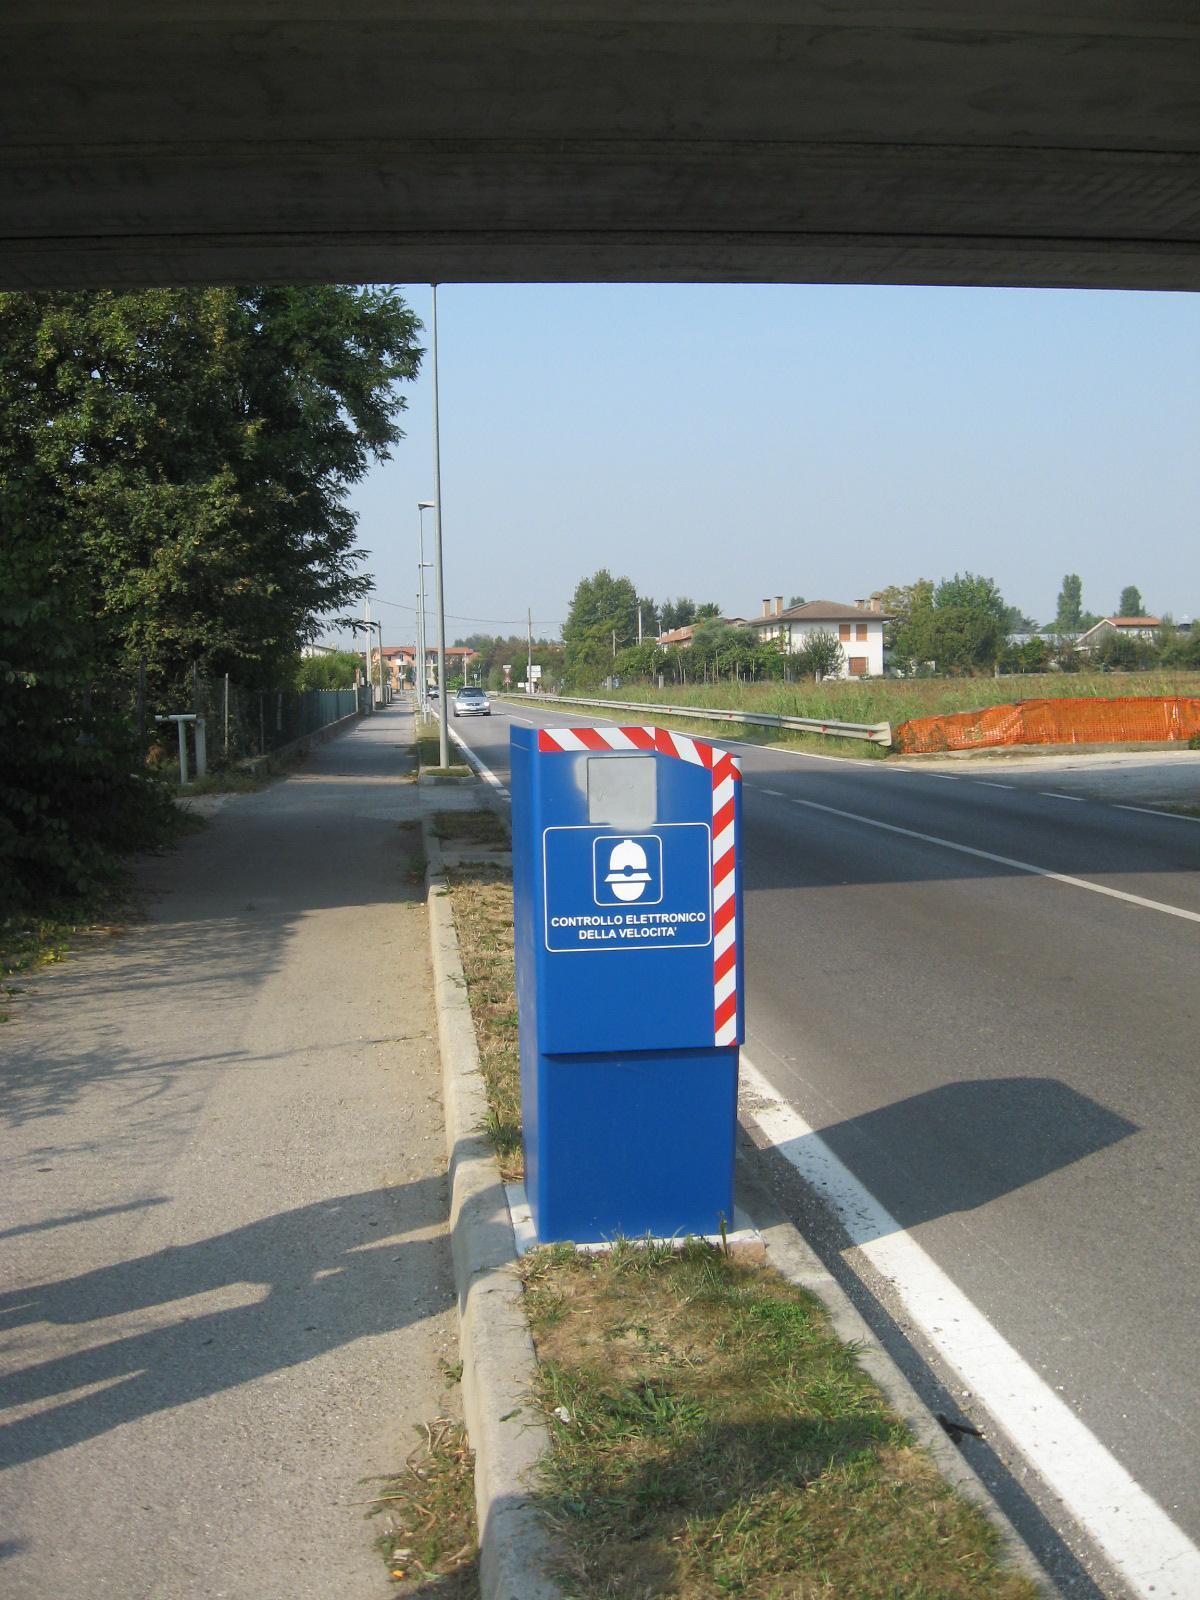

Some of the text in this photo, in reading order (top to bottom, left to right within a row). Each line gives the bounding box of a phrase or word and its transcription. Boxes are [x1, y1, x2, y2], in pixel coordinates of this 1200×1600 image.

[551, 912, 706, 927] CONTROLLO ELETTRONICO
[578, 927, 677, 940] DELLA VELOCITA'
